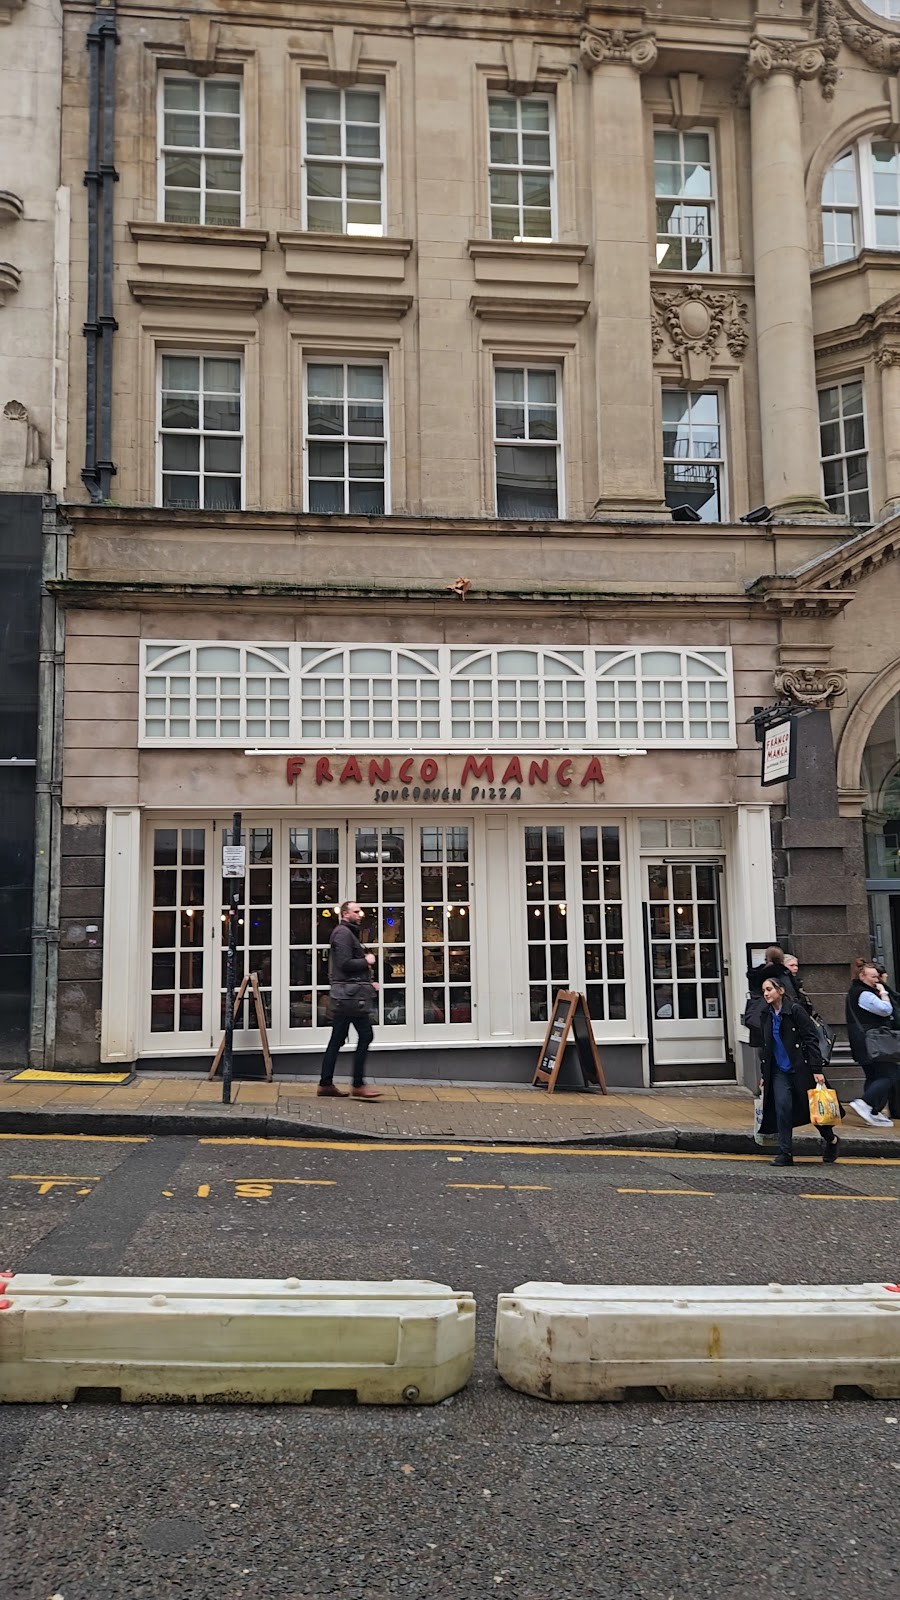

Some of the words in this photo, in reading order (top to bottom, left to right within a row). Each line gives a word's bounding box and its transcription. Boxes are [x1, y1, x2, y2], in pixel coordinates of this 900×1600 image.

[767, 733, 789, 748] FRANCO
[767, 746, 788, 759] MANCA
[286, 756, 438, 785] FRANCO
[460, 755, 605, 787] MANCA
[374, 786, 462, 803] SOURDOUGH
[471, 786, 522, 801] PIZZA
[32, 1180, 274, 1198] TIS
